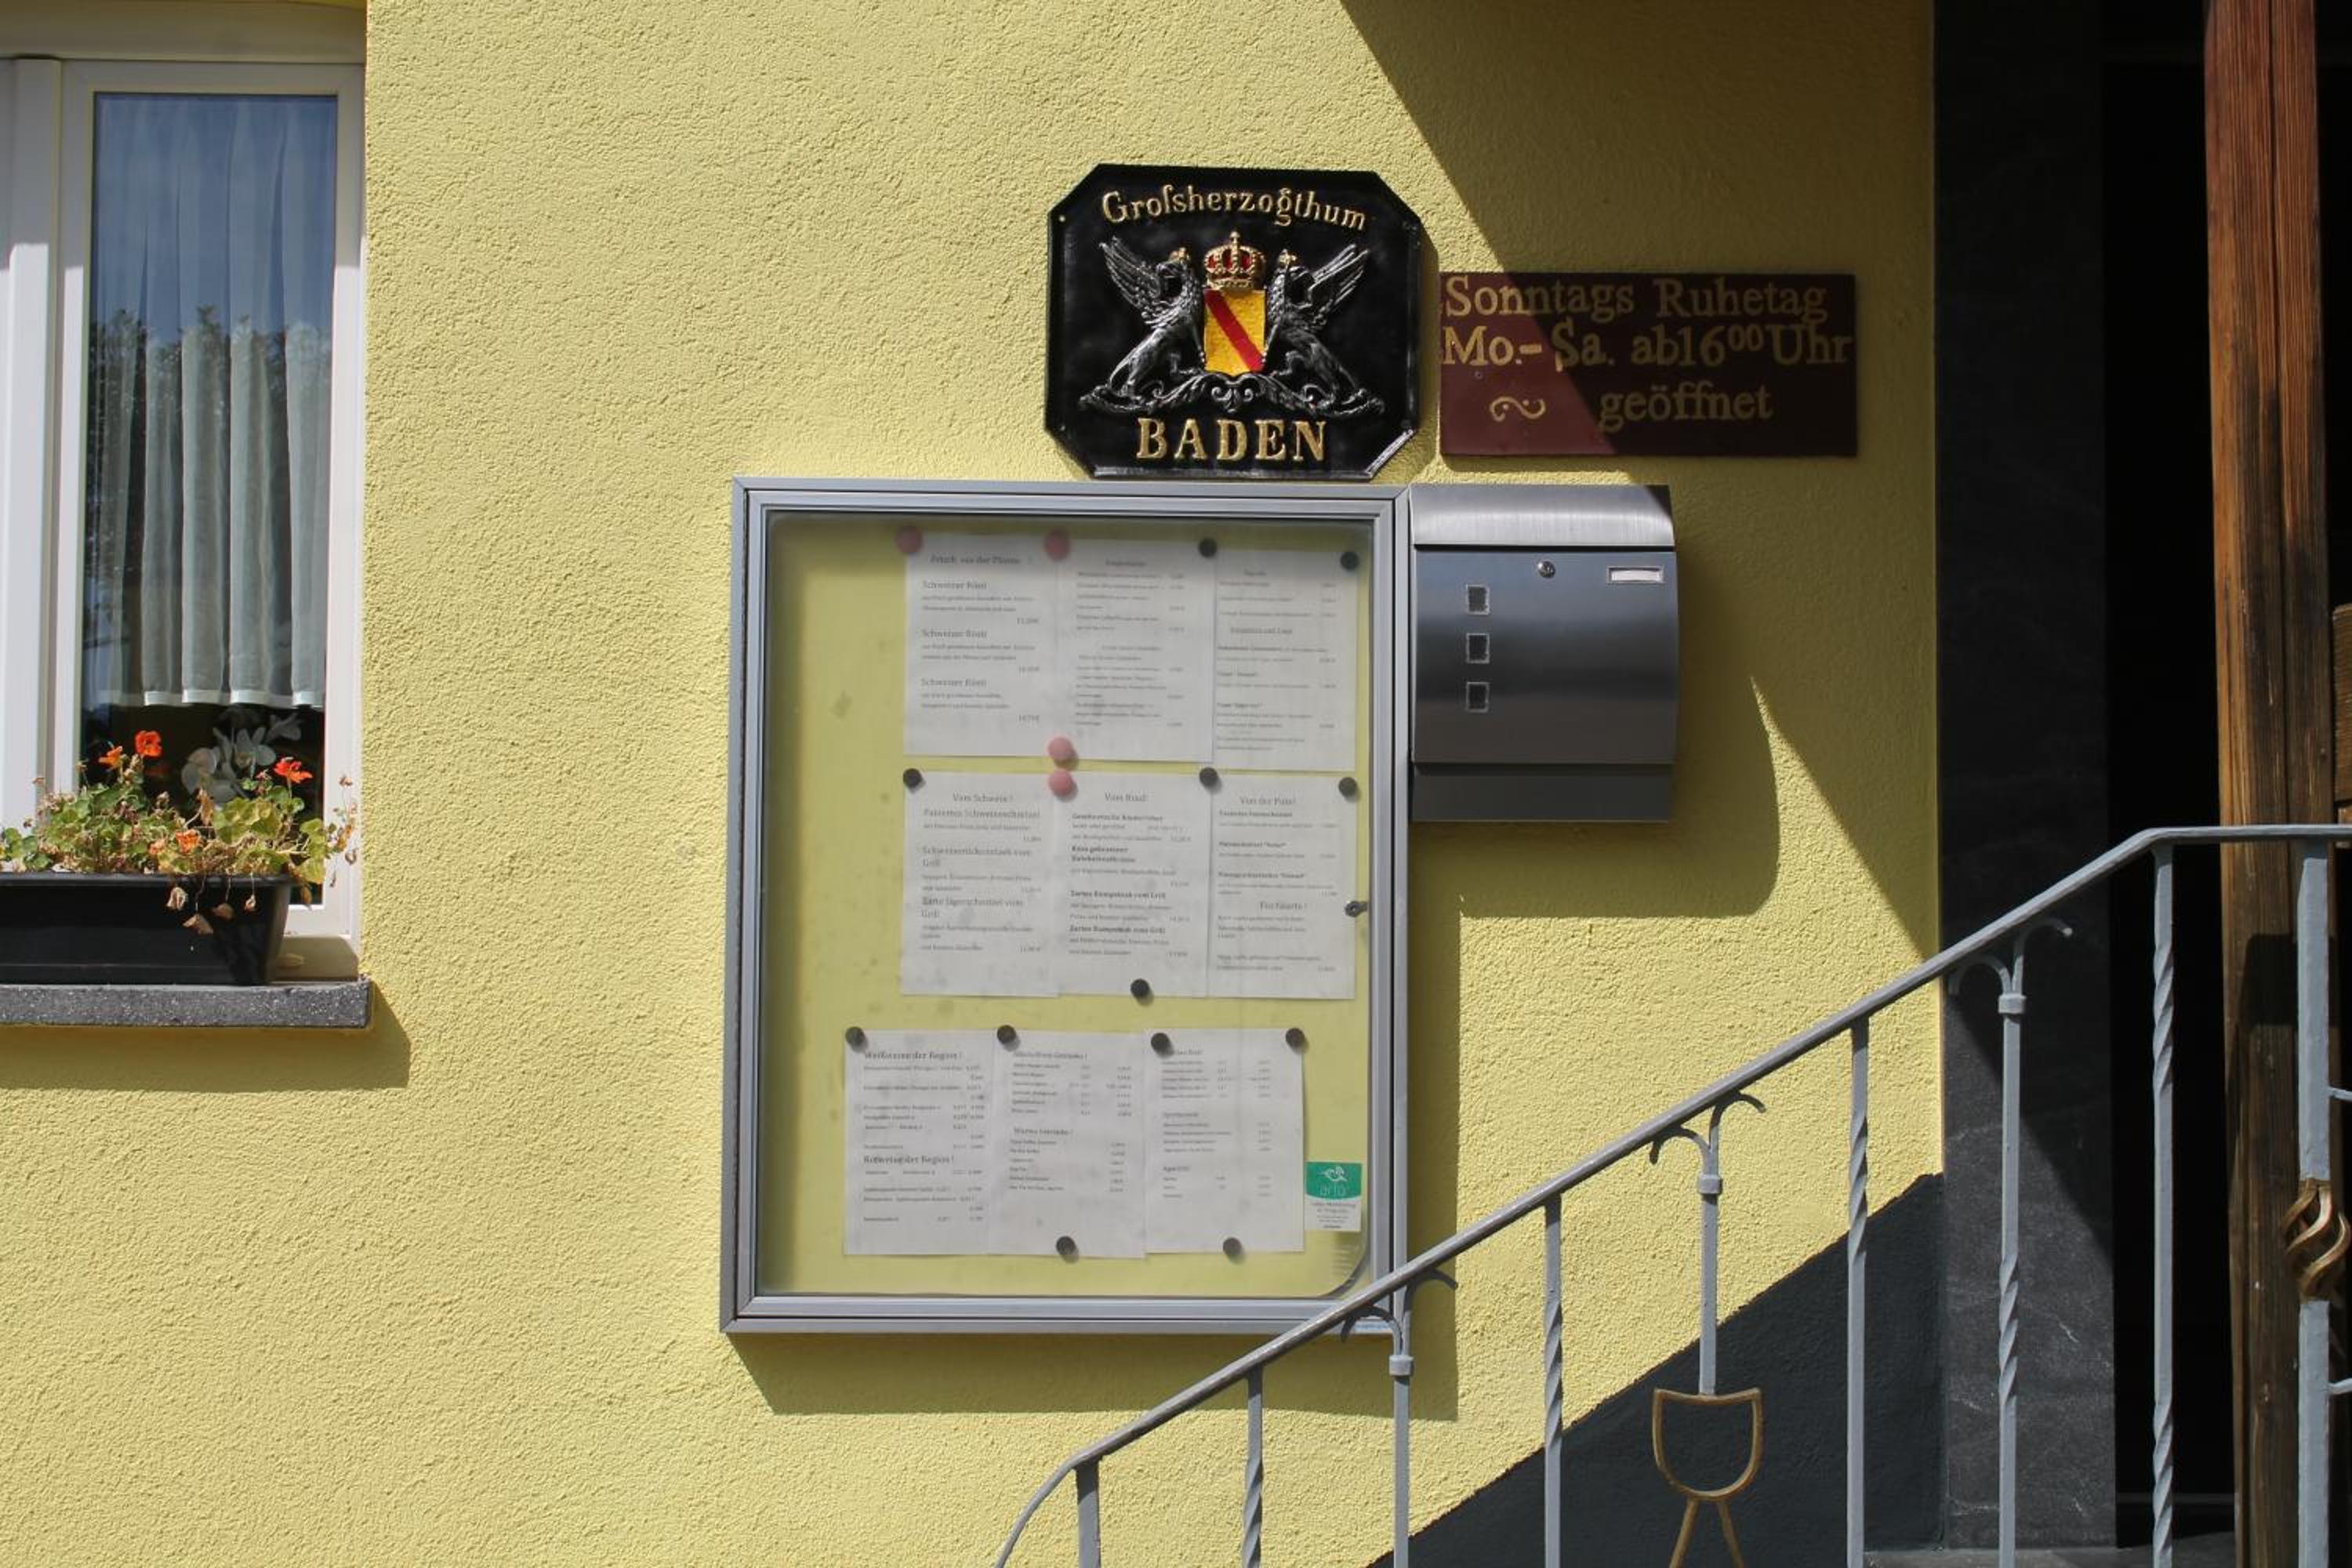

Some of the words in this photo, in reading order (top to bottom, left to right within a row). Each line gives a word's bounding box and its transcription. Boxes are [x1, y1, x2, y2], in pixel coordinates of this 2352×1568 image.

[1444, 274, 1636, 325] Sonntags
[1652, 274, 1829, 325] Ruhetag
[1596, 379, 1775, 435] geöffnet
[1136, 417, 1327, 461] BADEN
